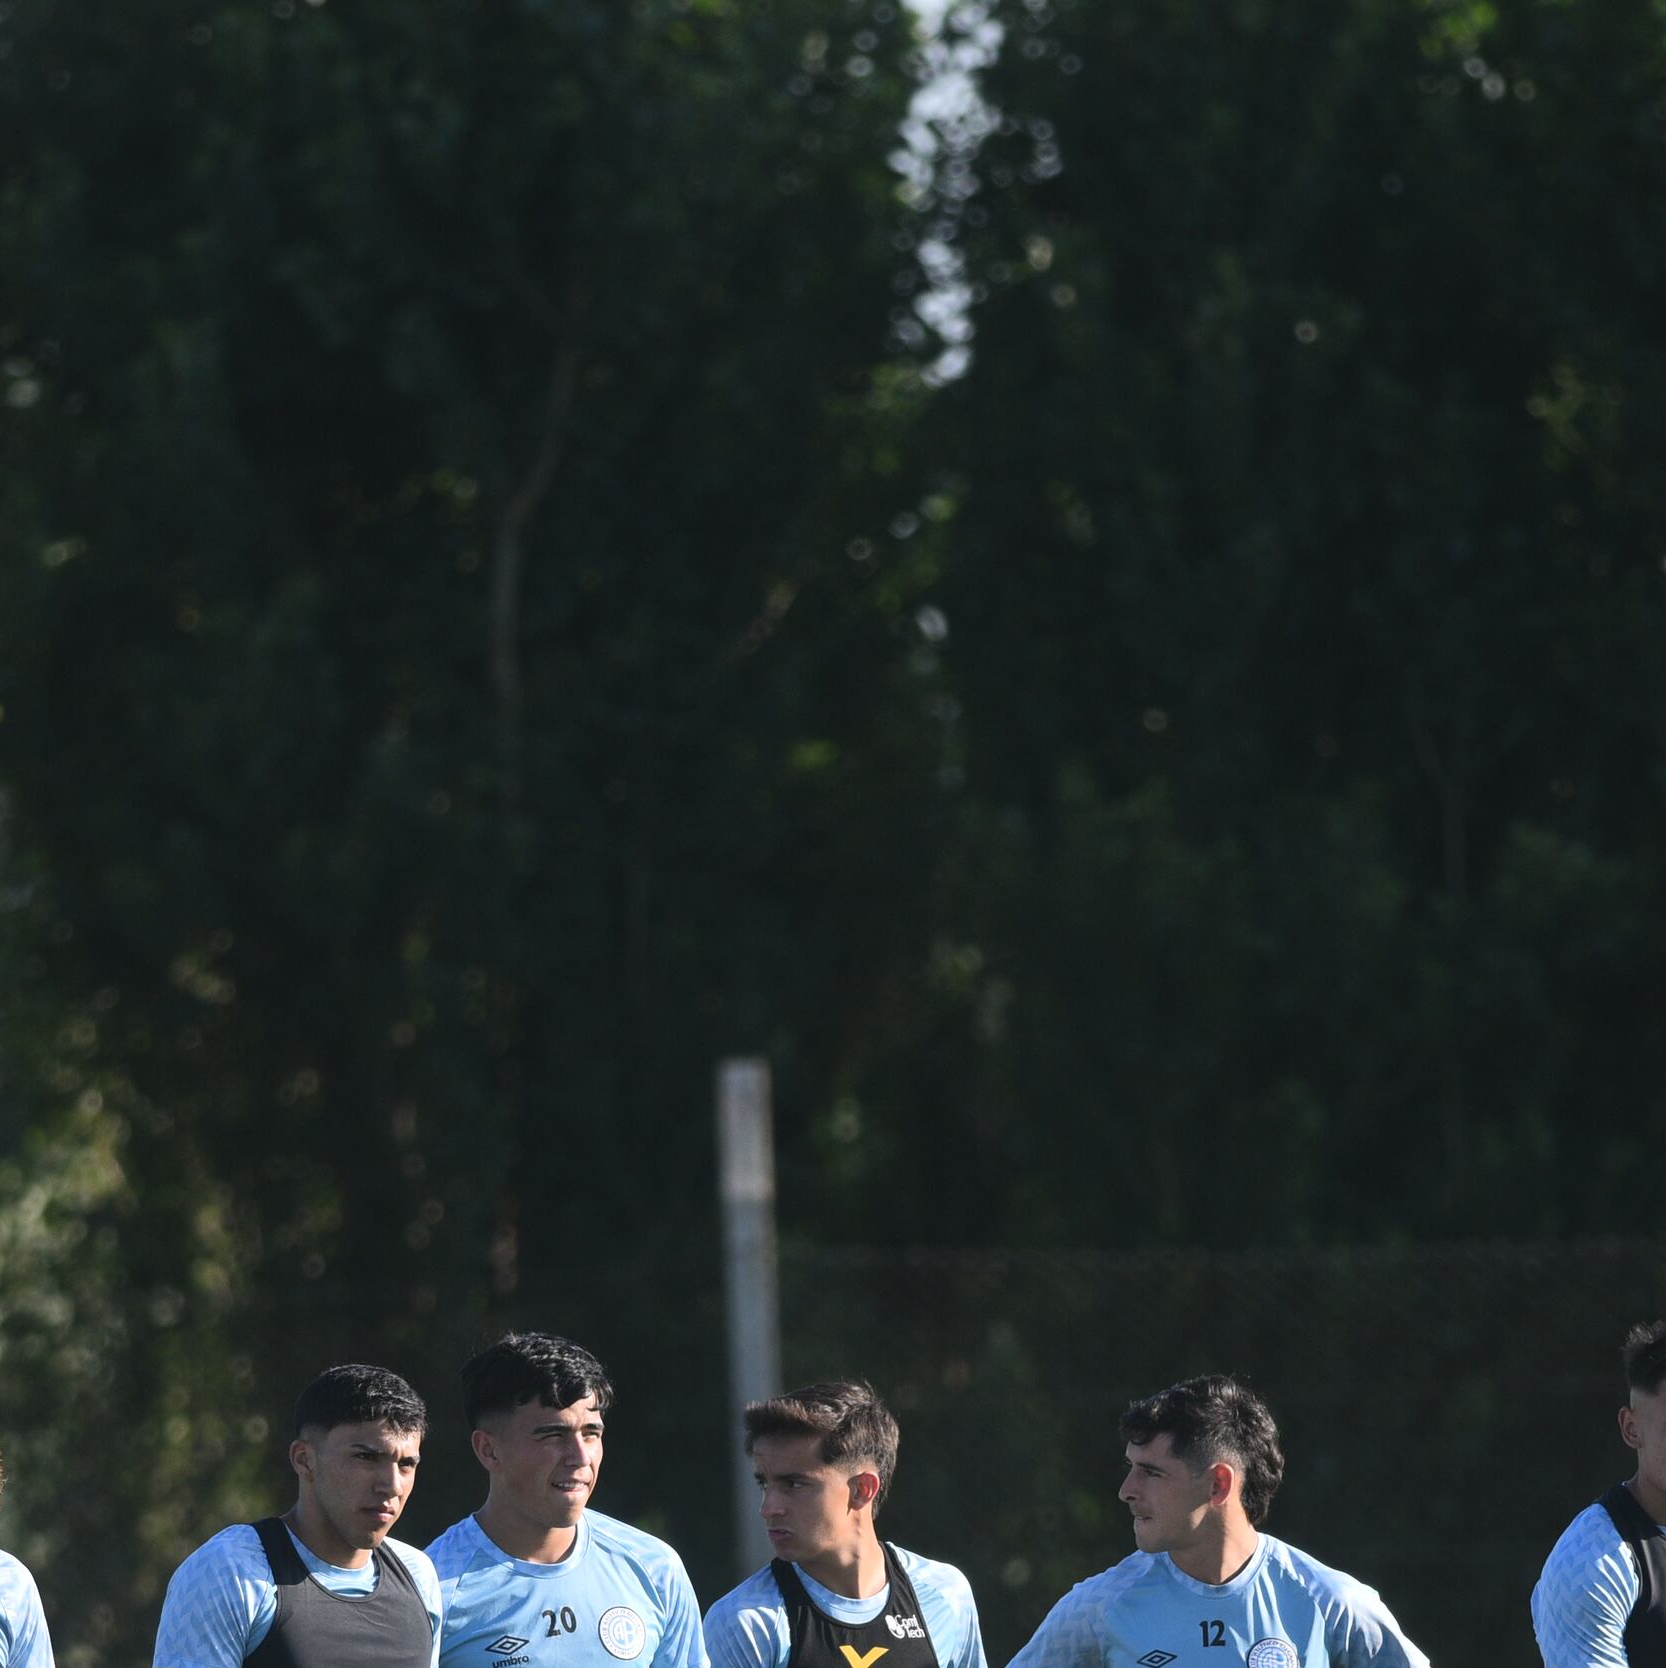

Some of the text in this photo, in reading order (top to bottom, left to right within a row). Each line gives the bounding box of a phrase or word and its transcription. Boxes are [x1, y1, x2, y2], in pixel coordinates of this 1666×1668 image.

[542, 1606, 577, 1637] 20
[906, 1627, 925, 1638] Tech
[1199, 1620, 1226, 1647] 12
[492, 1655, 529, 1668] umbro
